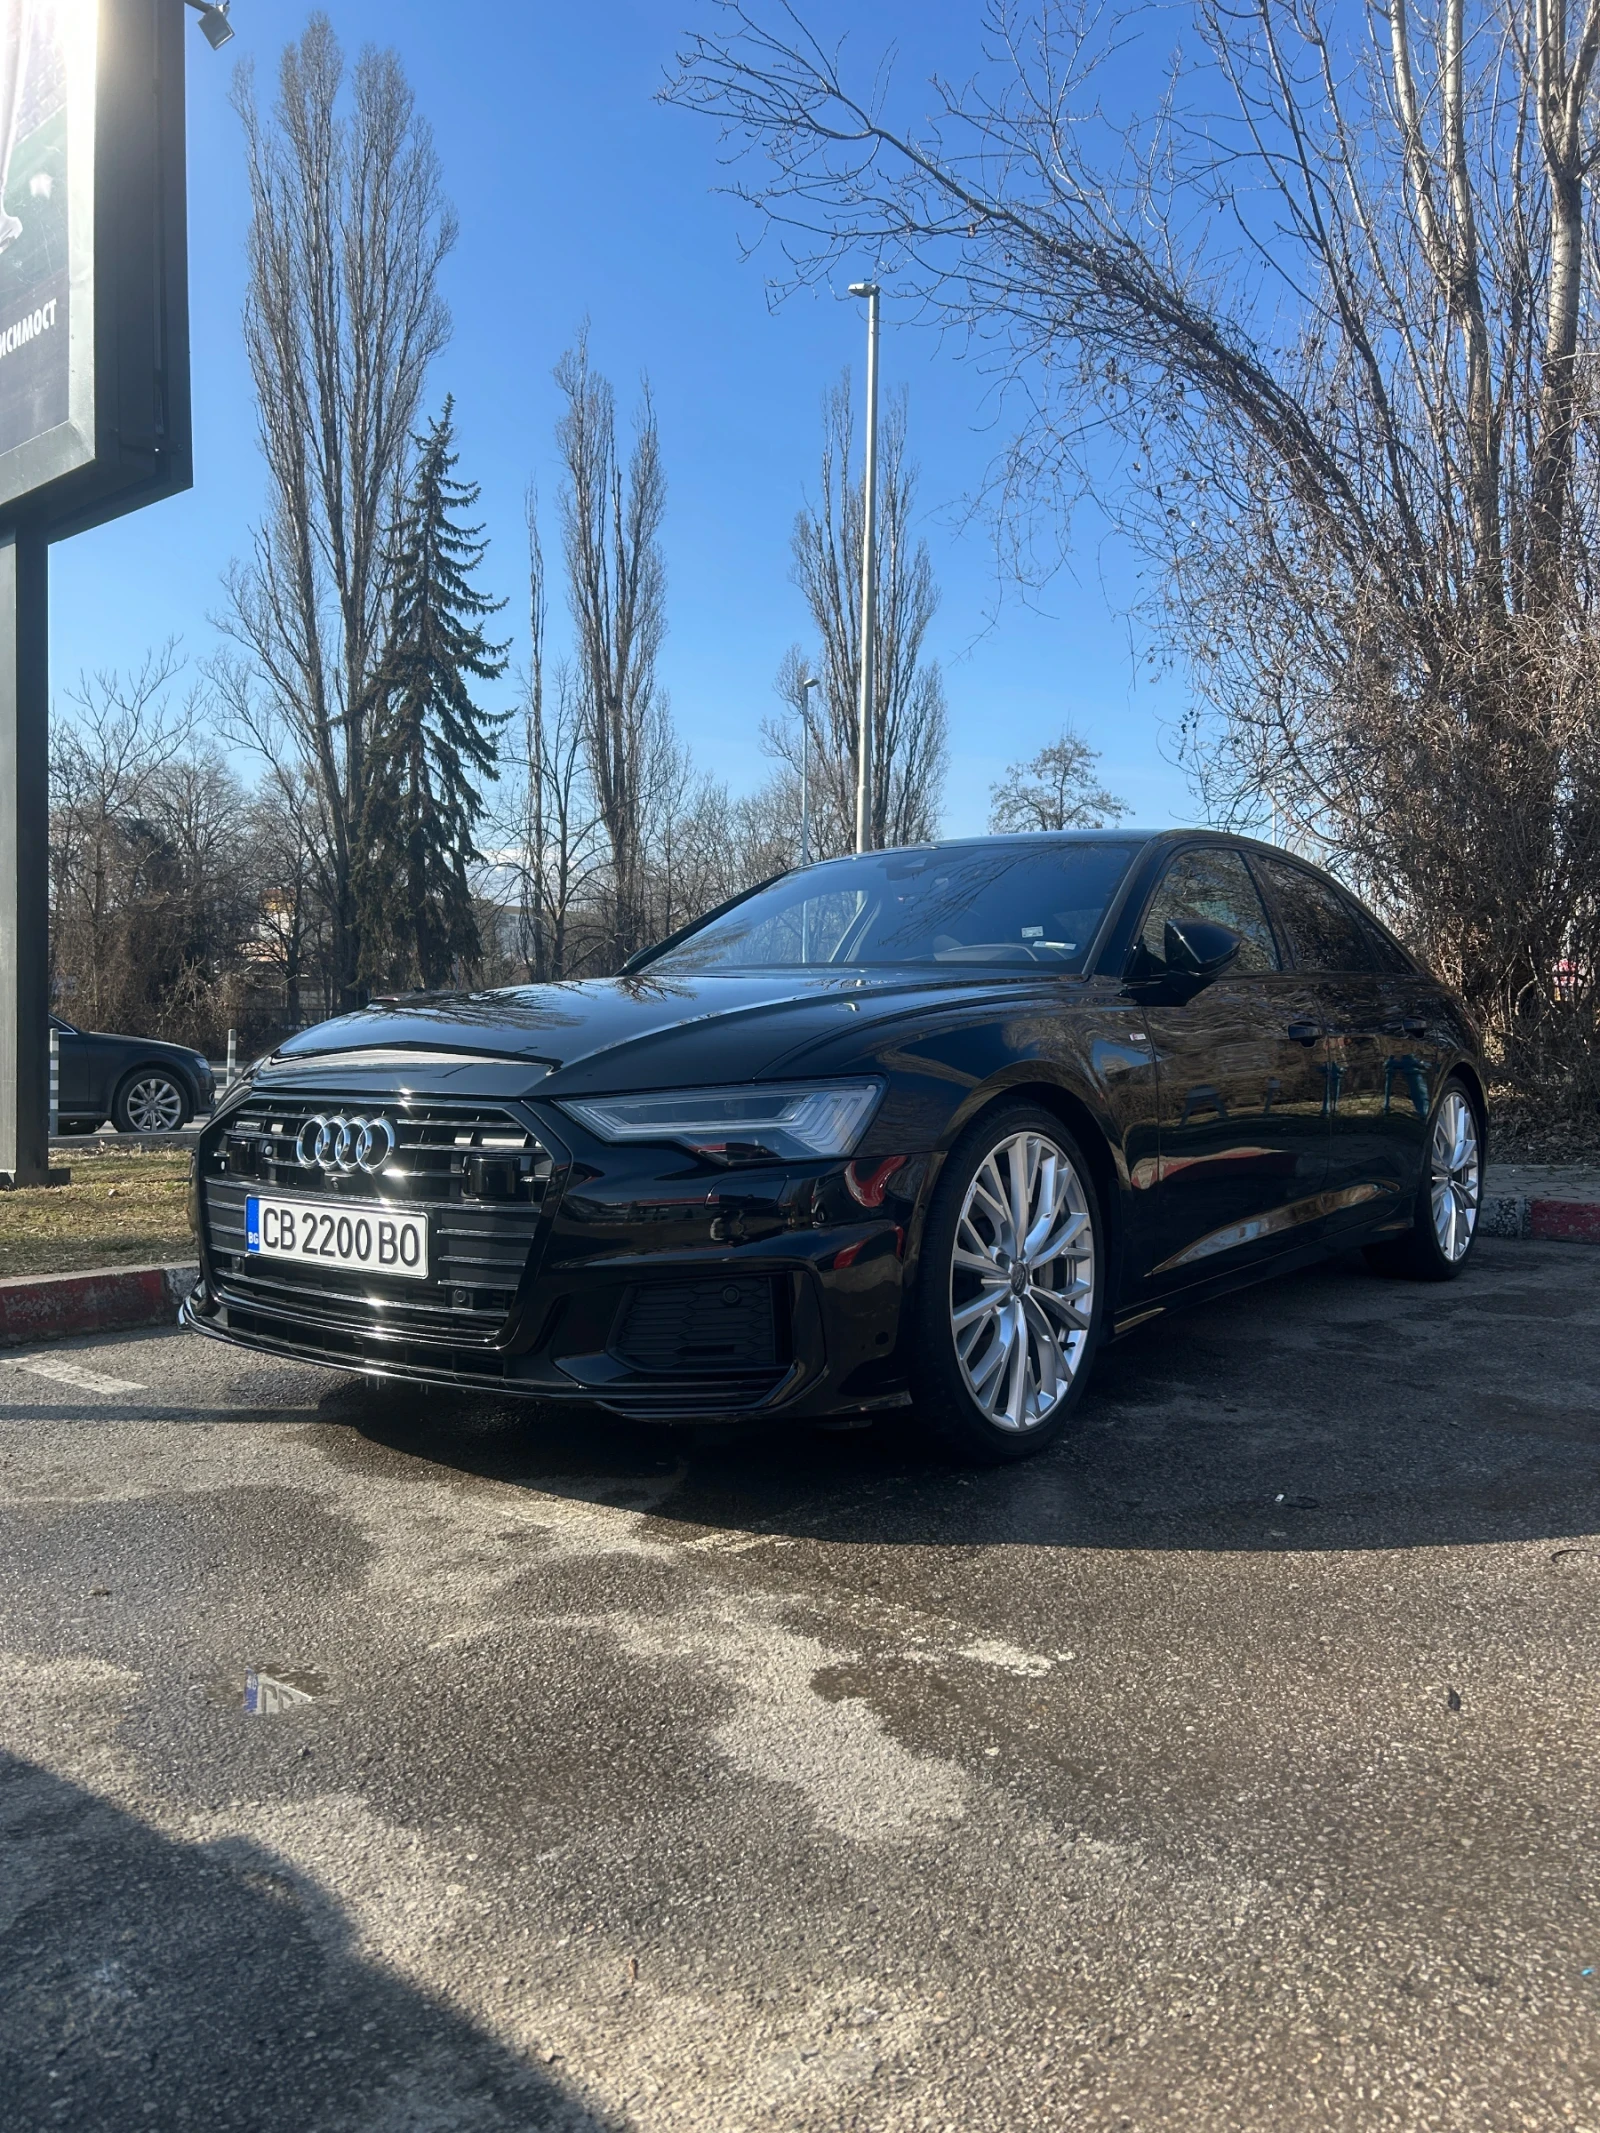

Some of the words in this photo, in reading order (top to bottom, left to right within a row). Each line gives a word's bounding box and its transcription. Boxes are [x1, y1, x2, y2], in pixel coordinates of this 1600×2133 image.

[247, 1231, 259, 1245] BG
[263, 1207, 296, 1251] CB
[302, 1212, 372, 1261] 2200
